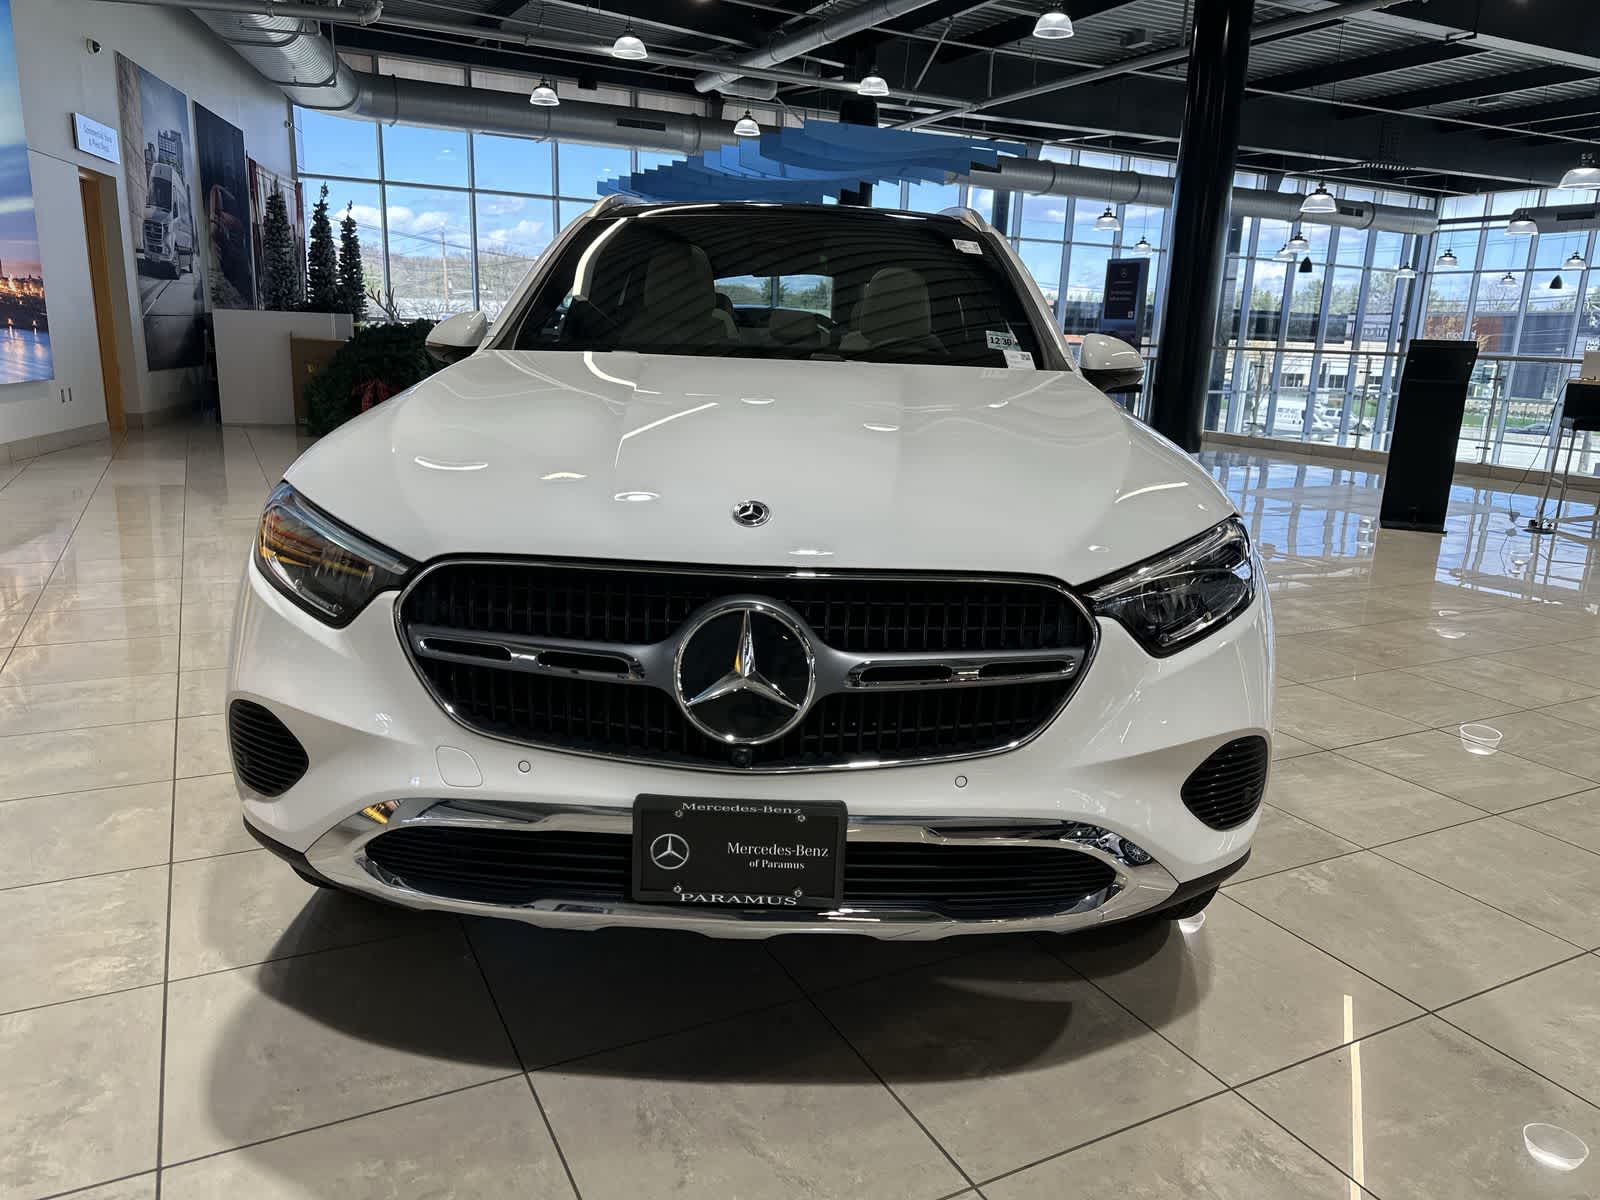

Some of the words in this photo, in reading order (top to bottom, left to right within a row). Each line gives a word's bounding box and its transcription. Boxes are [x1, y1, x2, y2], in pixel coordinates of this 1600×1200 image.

[681, 802, 802, 815] Mercedes-Benz
[727, 841, 829, 857] Mercedes-Benz
[749, 859, 760, 868] of
[761, 859, 805, 870] Paramus
[680, 893, 798, 906] PARAMUS
